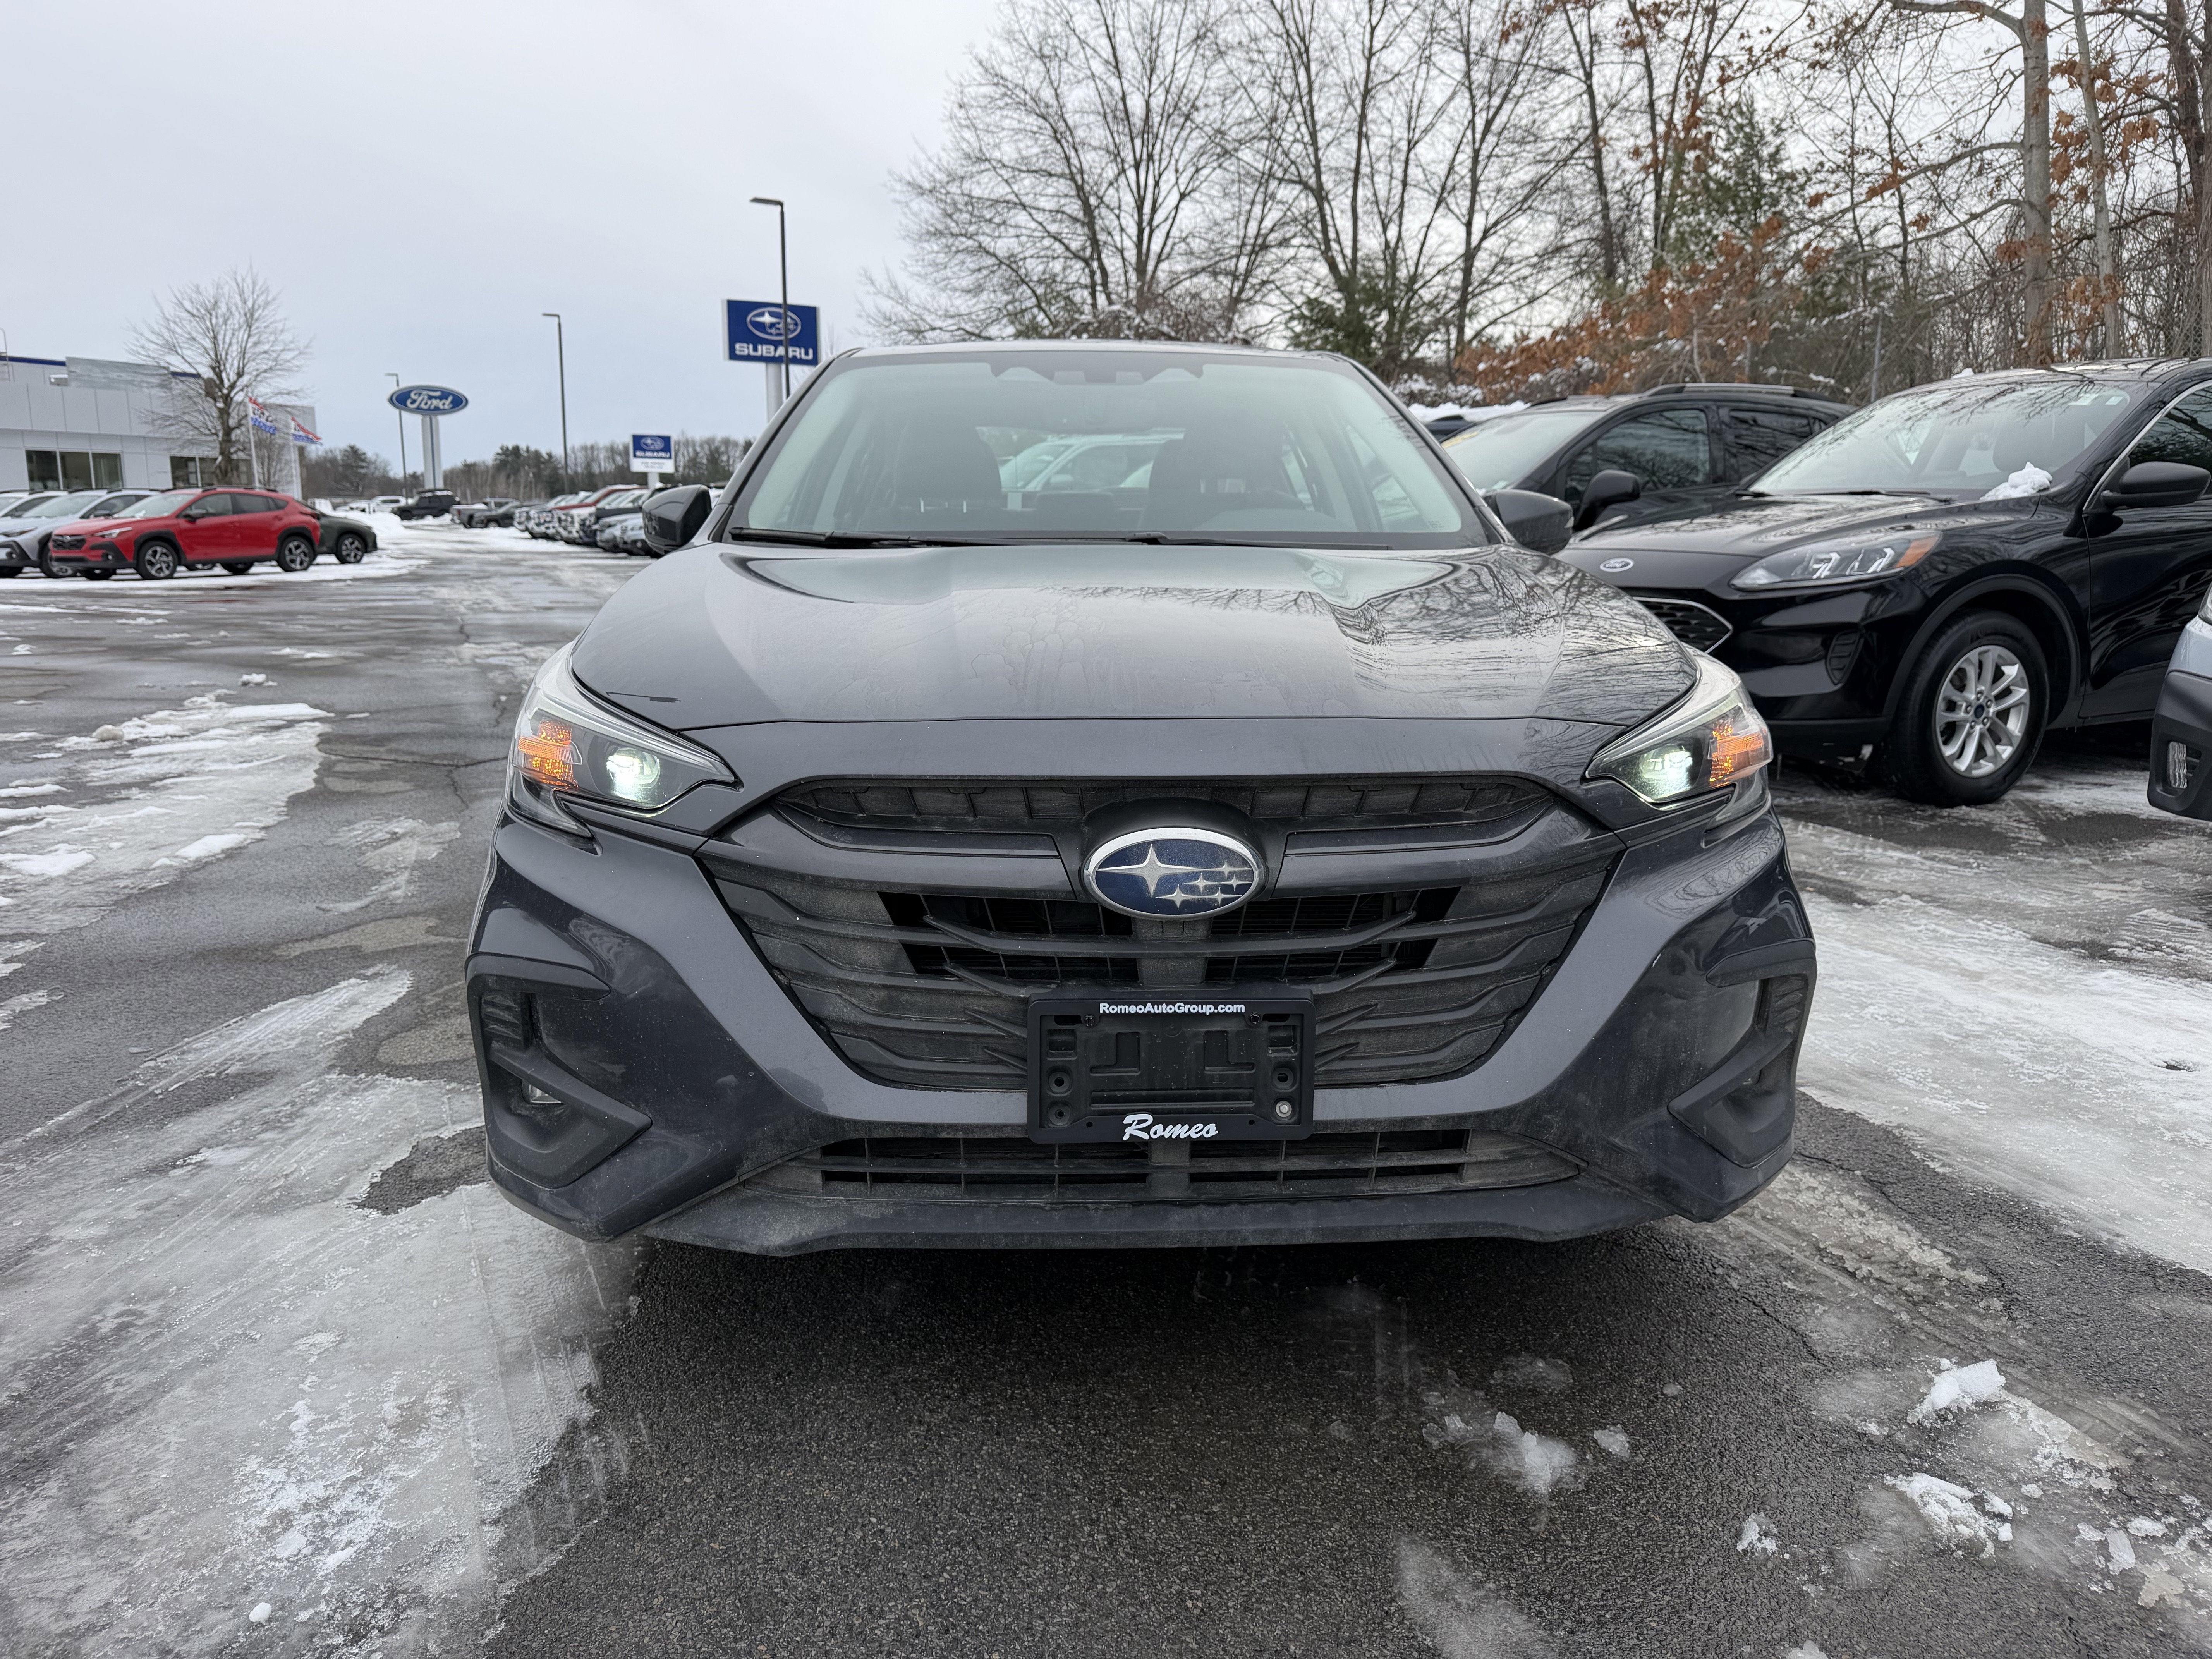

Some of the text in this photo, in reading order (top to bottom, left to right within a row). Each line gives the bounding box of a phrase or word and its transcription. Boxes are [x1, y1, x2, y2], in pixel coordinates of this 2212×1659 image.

[735, 342, 813, 360] SUBARU
[407, 389, 453, 409] Ford
[1100, 1002, 1245, 1015] RomeoAutoGroup.com
[1123, 1113, 1218, 1140] Romeo
